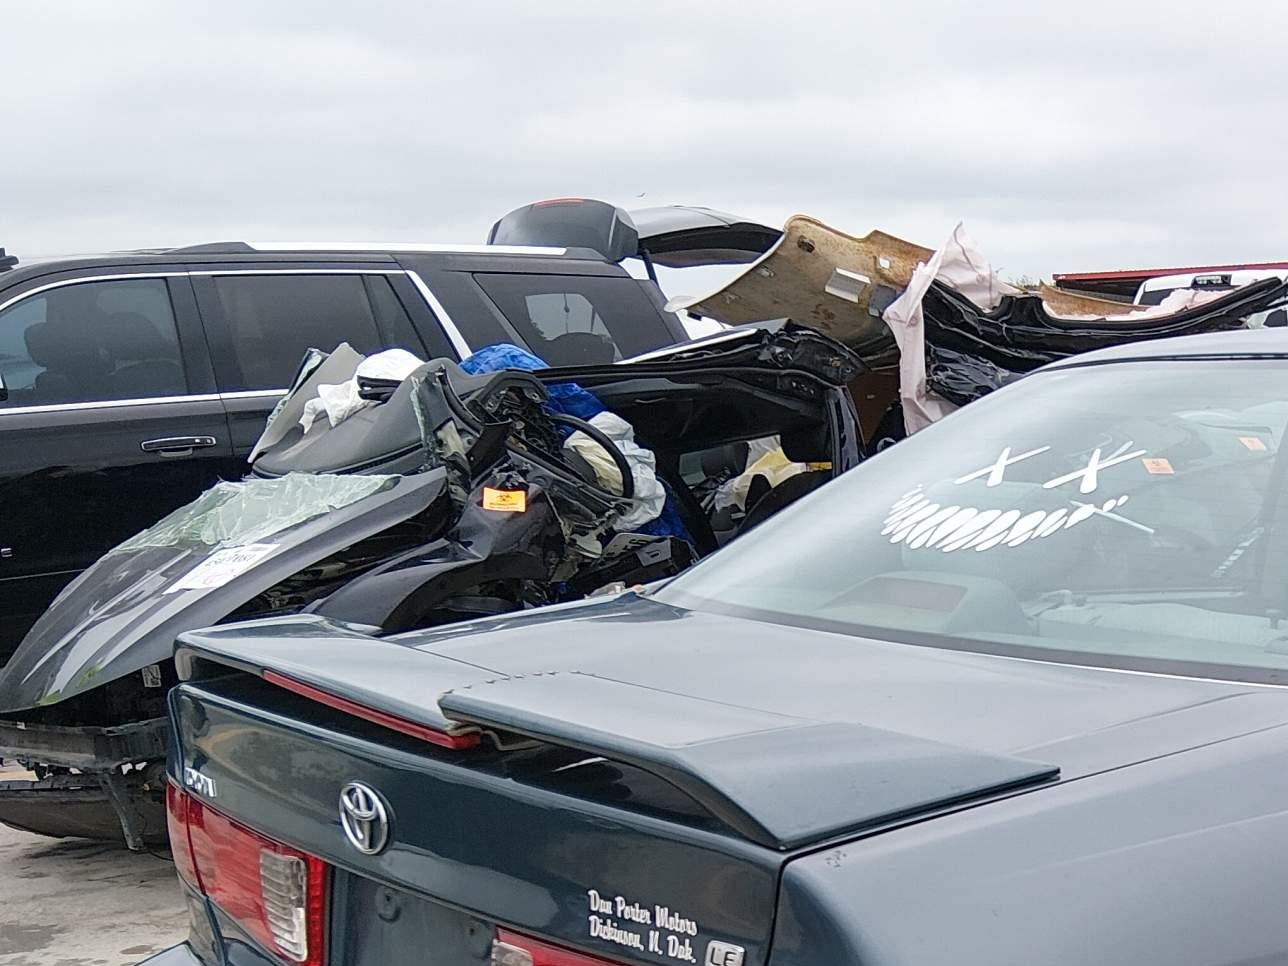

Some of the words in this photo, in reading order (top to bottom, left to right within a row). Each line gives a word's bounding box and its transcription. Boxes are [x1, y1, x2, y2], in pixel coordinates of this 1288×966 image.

[588, 890, 613, 915] Dan
[615, 896, 652, 925] Porter
[655, 905, 698, 936] Motors
[588, 915, 645, 951] Dickinson,
[666, 935, 697, 963] Dak.
